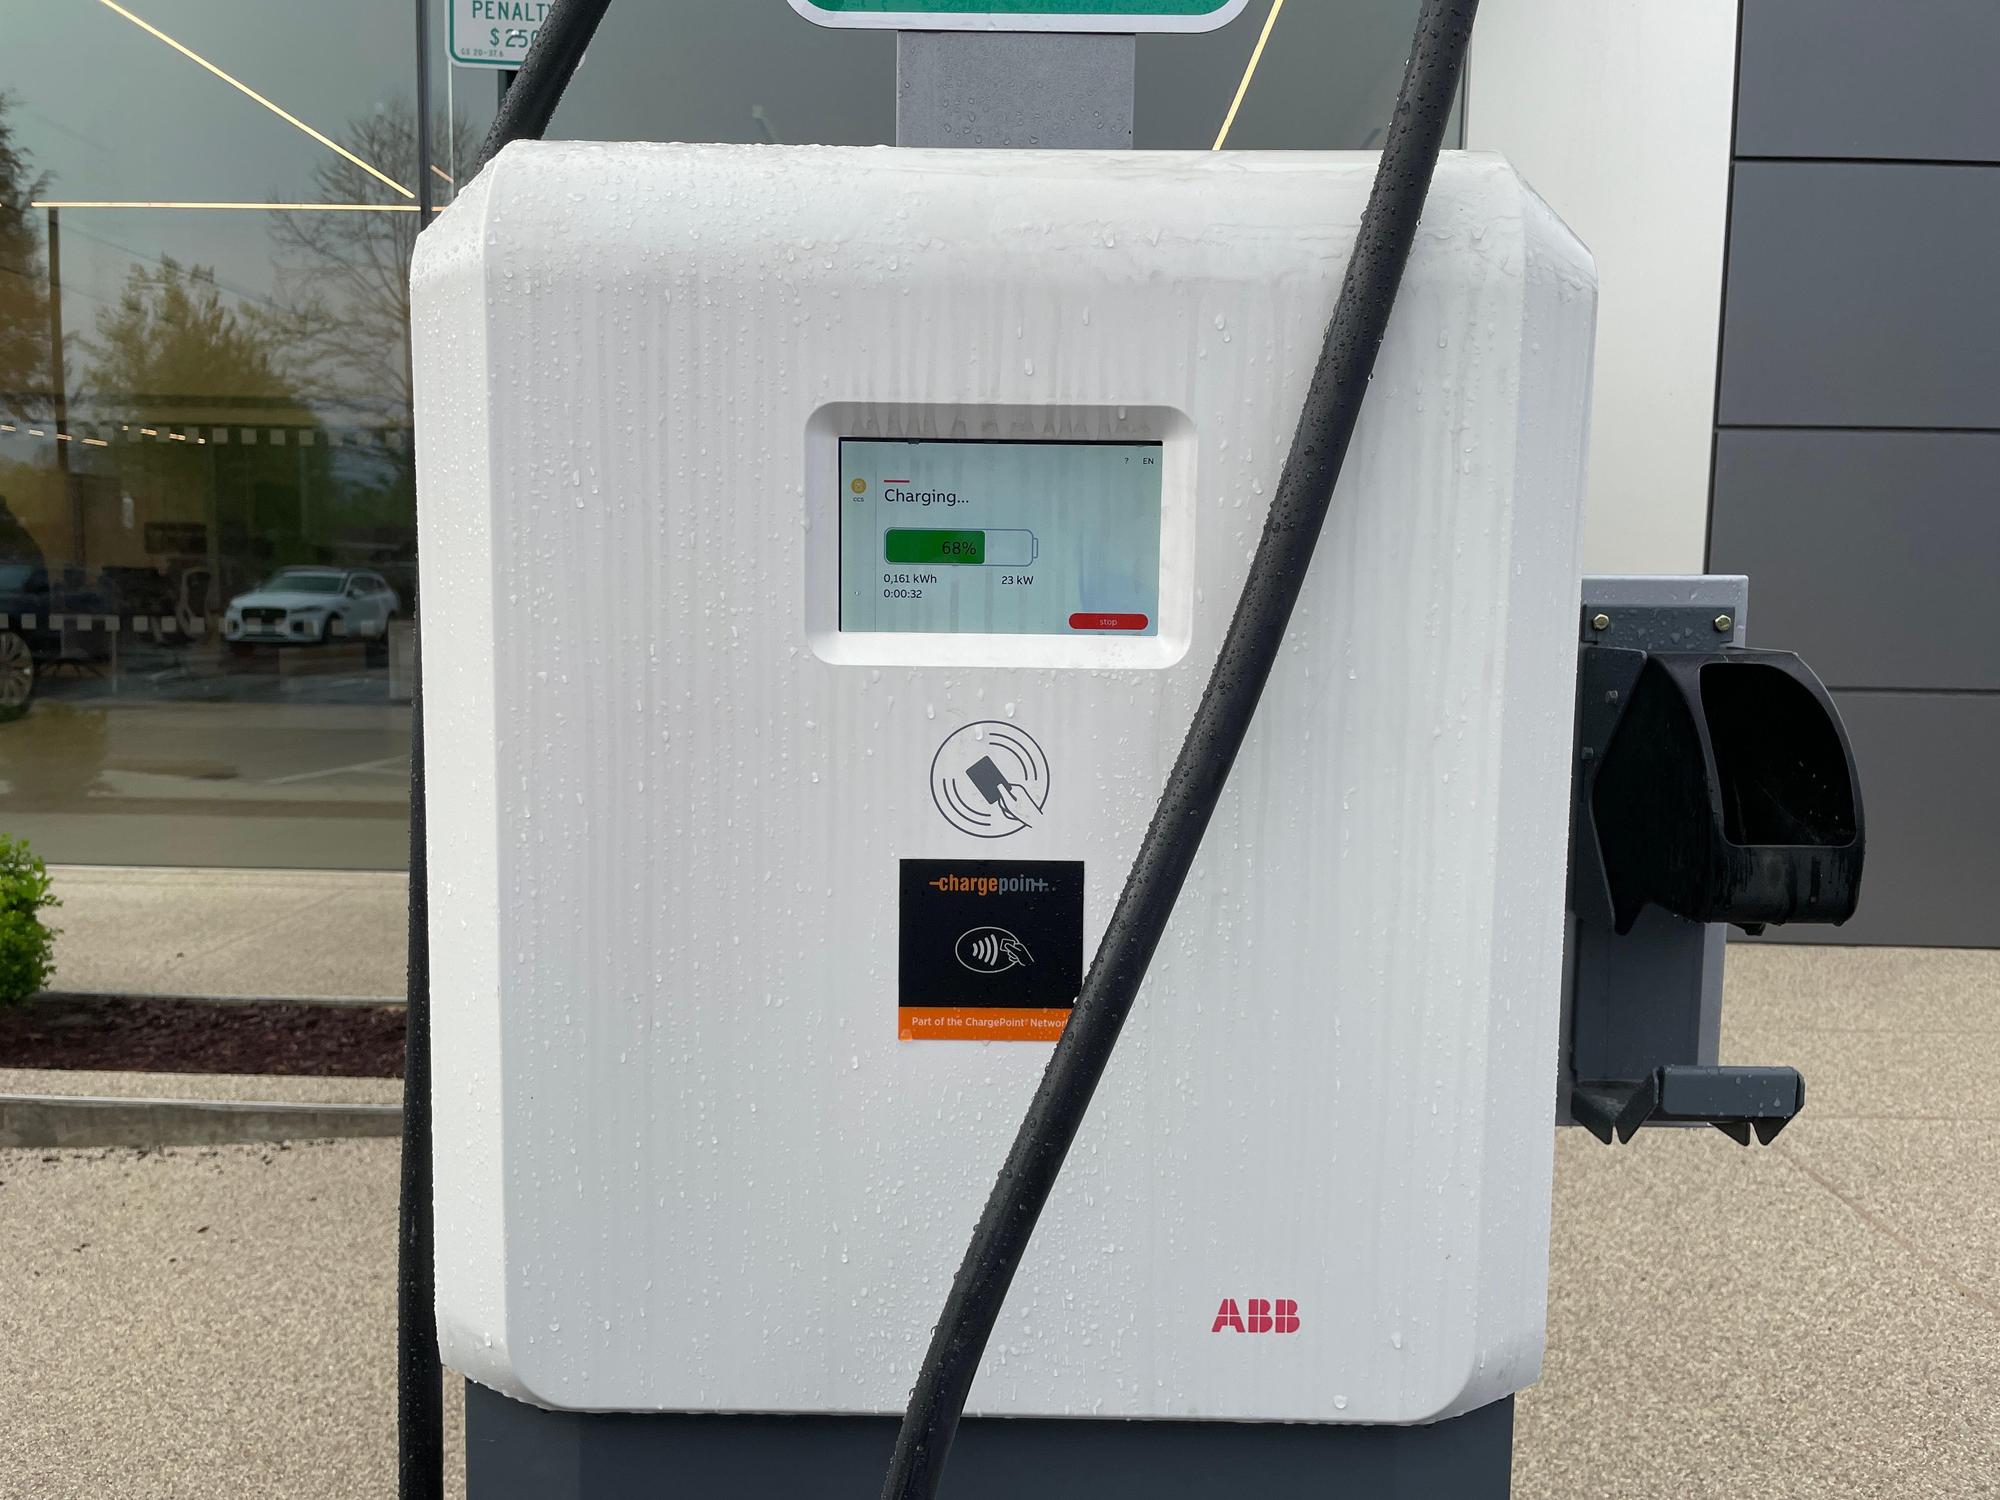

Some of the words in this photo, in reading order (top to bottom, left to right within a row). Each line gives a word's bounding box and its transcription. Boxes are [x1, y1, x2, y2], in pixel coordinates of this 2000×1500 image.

[472, 1, 552, 22] PENALT
[1142, 457, 1154, 465] EN
[884, 488, 970, 507] Charging...
[942, 541, 977, 556] 68%
[883, 573, 910, 585] 0,161
[913, 573, 937, 584] kWh
[1001, 575, 1014, 586] 23
[1016, 575, 1034, 586] kW
[883, 589, 923, 599] 0:00:32
[1099, 618, 1118, 627] stop
[911, 1016, 932, 1027] Part
[934, 1016, 945, 1027] of
[947, 1016, 963, 1027] the
[1211, 1298, 1301, 1333] ABB
